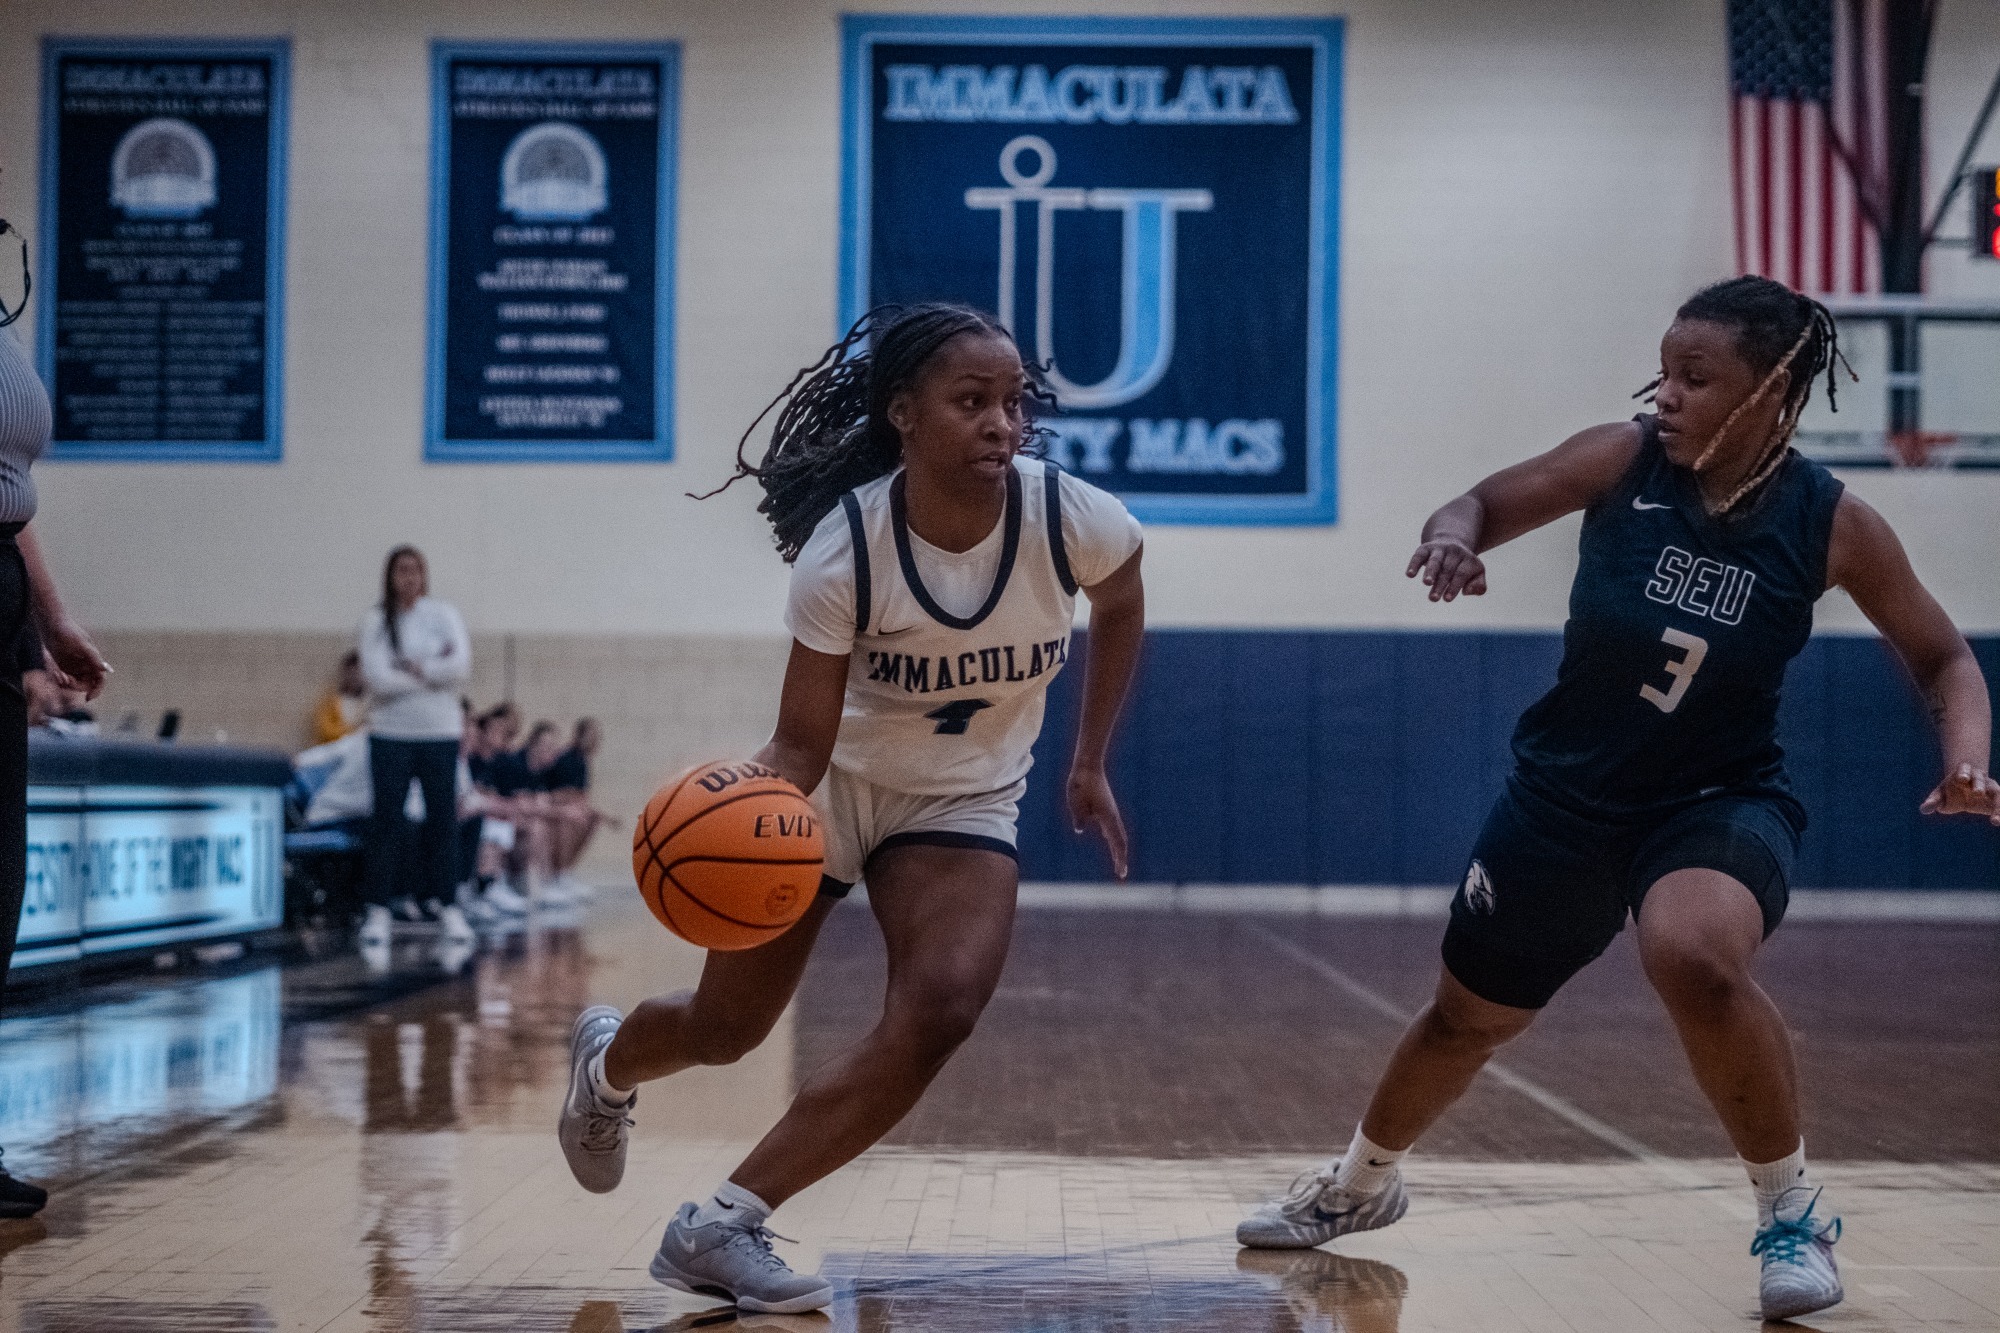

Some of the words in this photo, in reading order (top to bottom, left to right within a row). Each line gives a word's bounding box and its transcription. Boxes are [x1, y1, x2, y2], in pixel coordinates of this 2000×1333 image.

[884, 64, 1298, 124] IMMACULATA
[1127, 418, 1285, 475] MACS
[1645, 545, 1755, 626] SEU
[1639, 626, 1709, 714] 3
